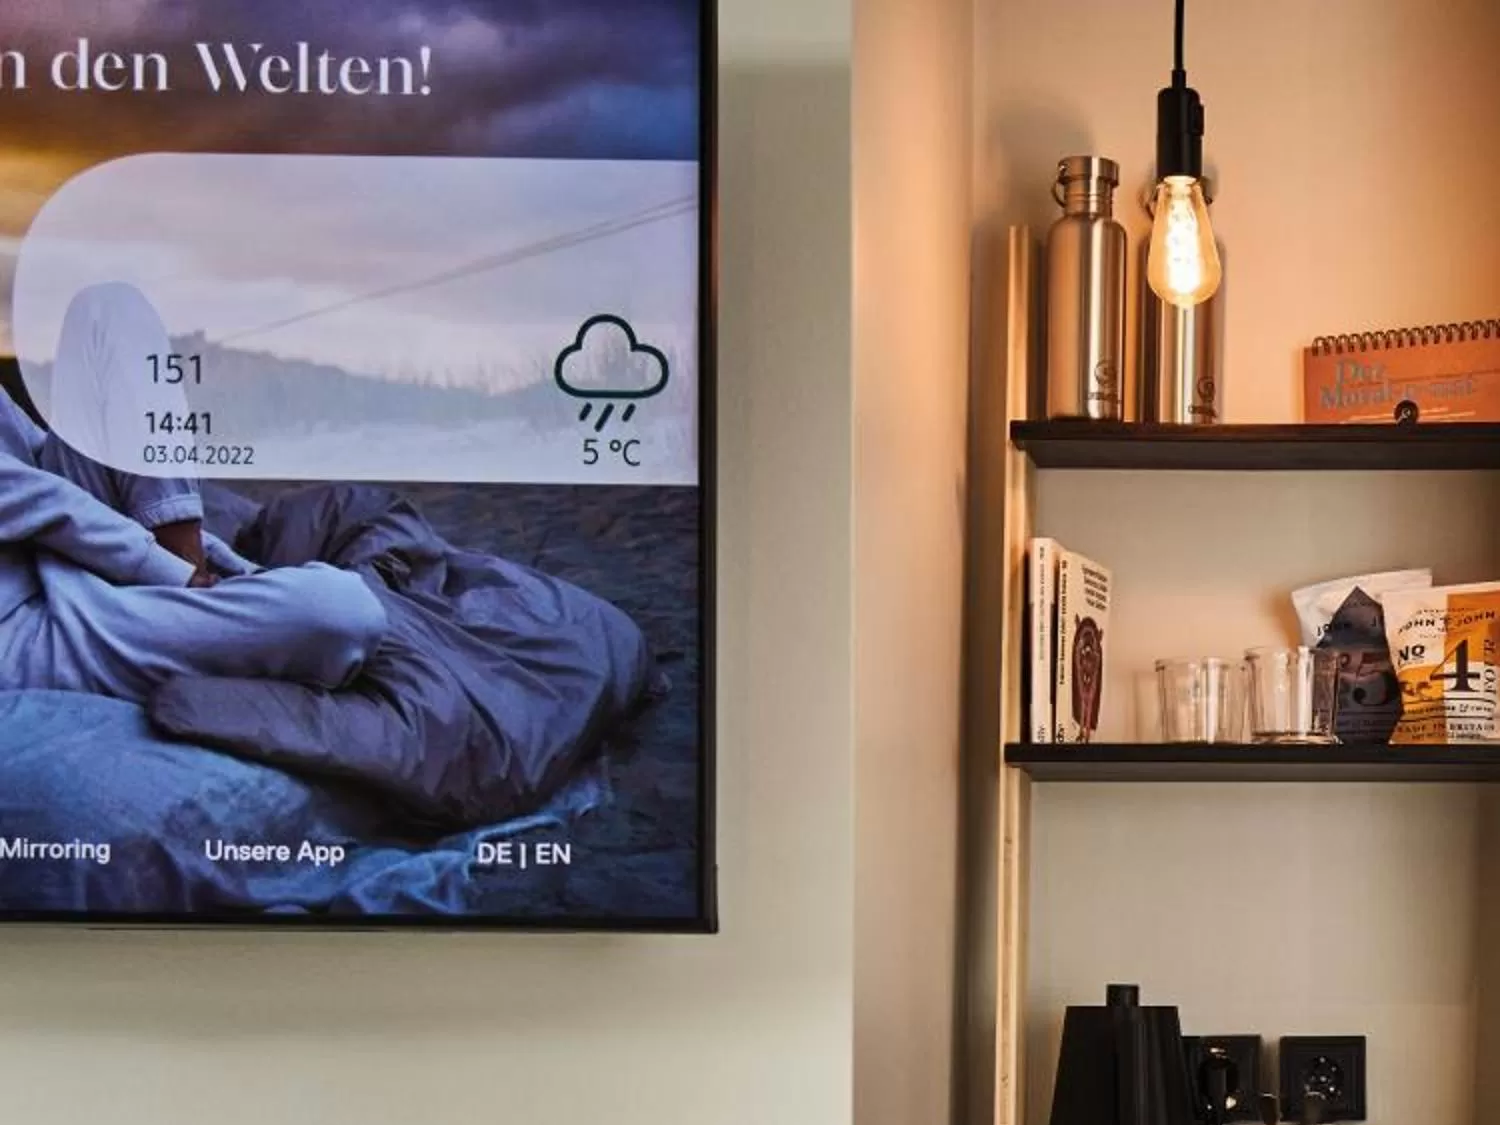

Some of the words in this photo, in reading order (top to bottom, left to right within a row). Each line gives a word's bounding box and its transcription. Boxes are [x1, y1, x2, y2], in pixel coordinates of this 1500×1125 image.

[51, 37, 171, 91] den
[195, 41, 432, 96] Welten!
[146, 353, 202, 385] 151
[145, 411, 213, 435] 14:41
[143, 445, 255, 466] 03.04.2022
[583, 438, 599, 465] 5
[609, 439, 641, 467] °C
[1429, 639, 1481, 693] 4
[0, 837, 111, 865] Mirroring
[205, 839, 290, 862] Unsere
[297, 840, 346, 867] App
[477, 842, 513, 865] DE
[535, 842, 571, 865] EN
